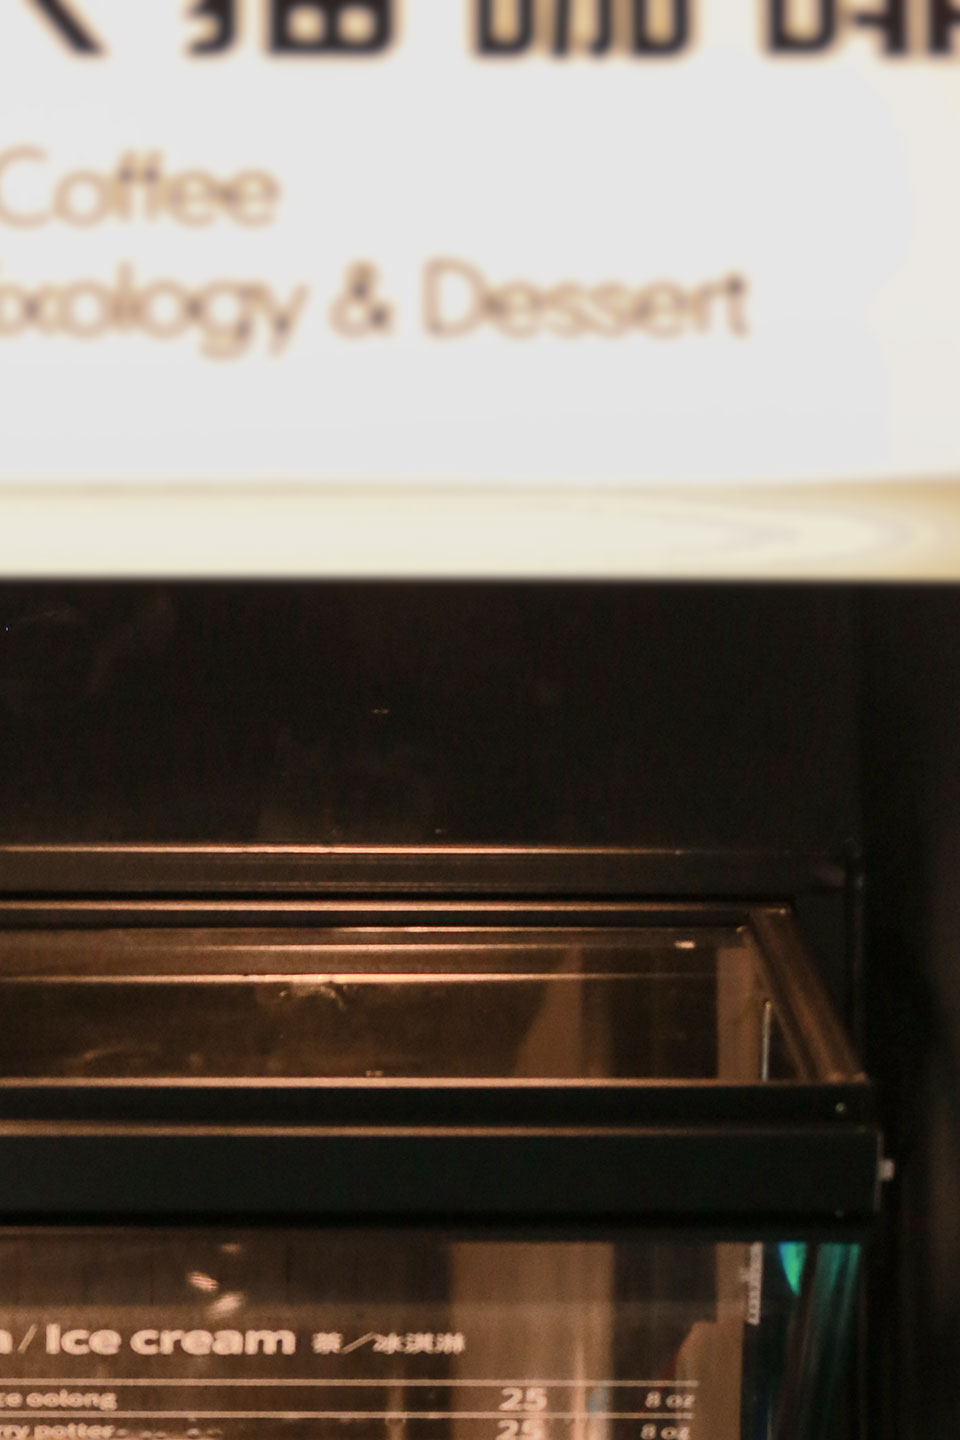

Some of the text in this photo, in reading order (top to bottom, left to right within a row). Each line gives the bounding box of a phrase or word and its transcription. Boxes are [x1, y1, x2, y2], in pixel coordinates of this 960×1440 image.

[331, 260, 394, 338] &
[423, 256, 750, 338] Dessert
[46, 1323, 122, 1355] Ice
[130, 1329, 296, 1355] cream
[26, 1388, 118, 1411] oolong
[498, 1387, 548, 1411] 25
[665, 1394, 695, 1408] oz
[34, 1422, 115, 1440] potter
